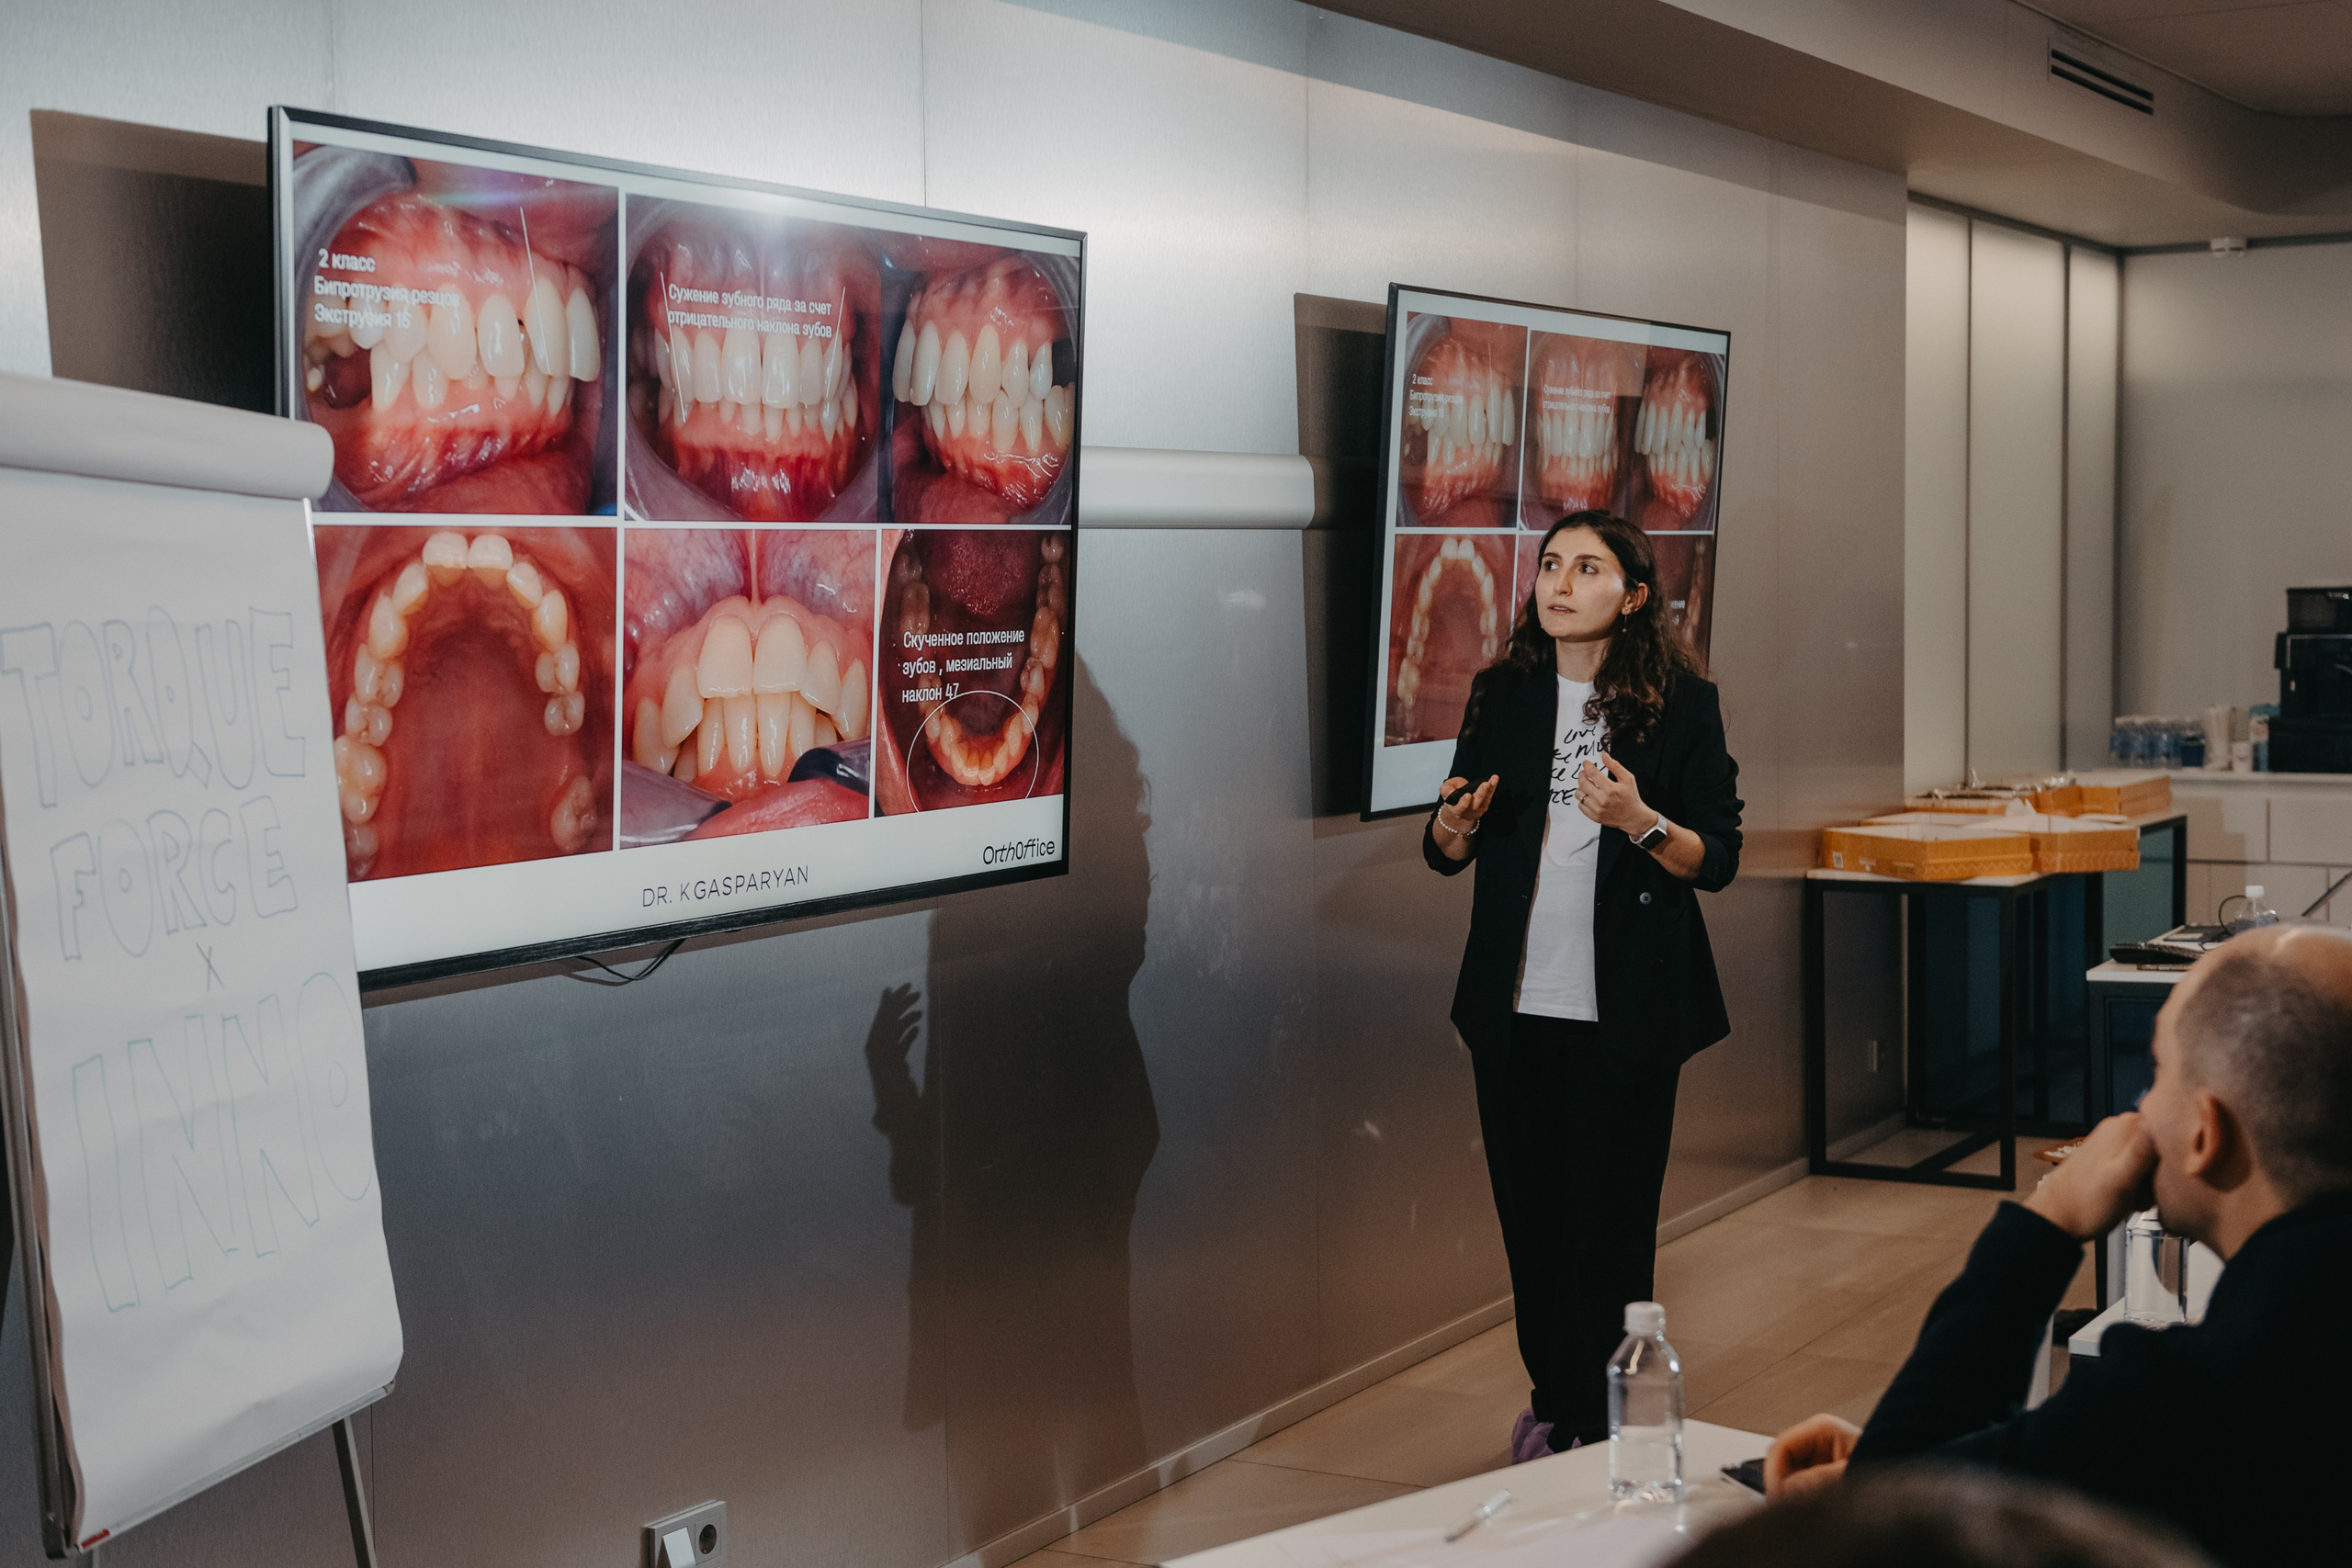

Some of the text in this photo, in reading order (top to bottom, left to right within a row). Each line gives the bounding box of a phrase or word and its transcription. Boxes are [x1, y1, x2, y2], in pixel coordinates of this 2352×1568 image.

[319, 248, 376, 273] 2 класс
[314, 275, 460, 307] Бипротрузия резцов
[668, 283, 832, 316] Сужение зубного ряда за счет
[314, 303, 412, 329] Экструзия 16
[668, 310, 832, 340] отрицательного наклона зубов
[903, 629, 1025, 651] Скученное положение
[902, 657, 936, 678] зубов
[945, 652, 1012, 672] мезиальный
[901, 682, 960, 703] наклон 47
[0, 605, 306, 809] TORQUE
[50, 795, 300, 962] FORCE
[642, 886, 673, 908] DR.
